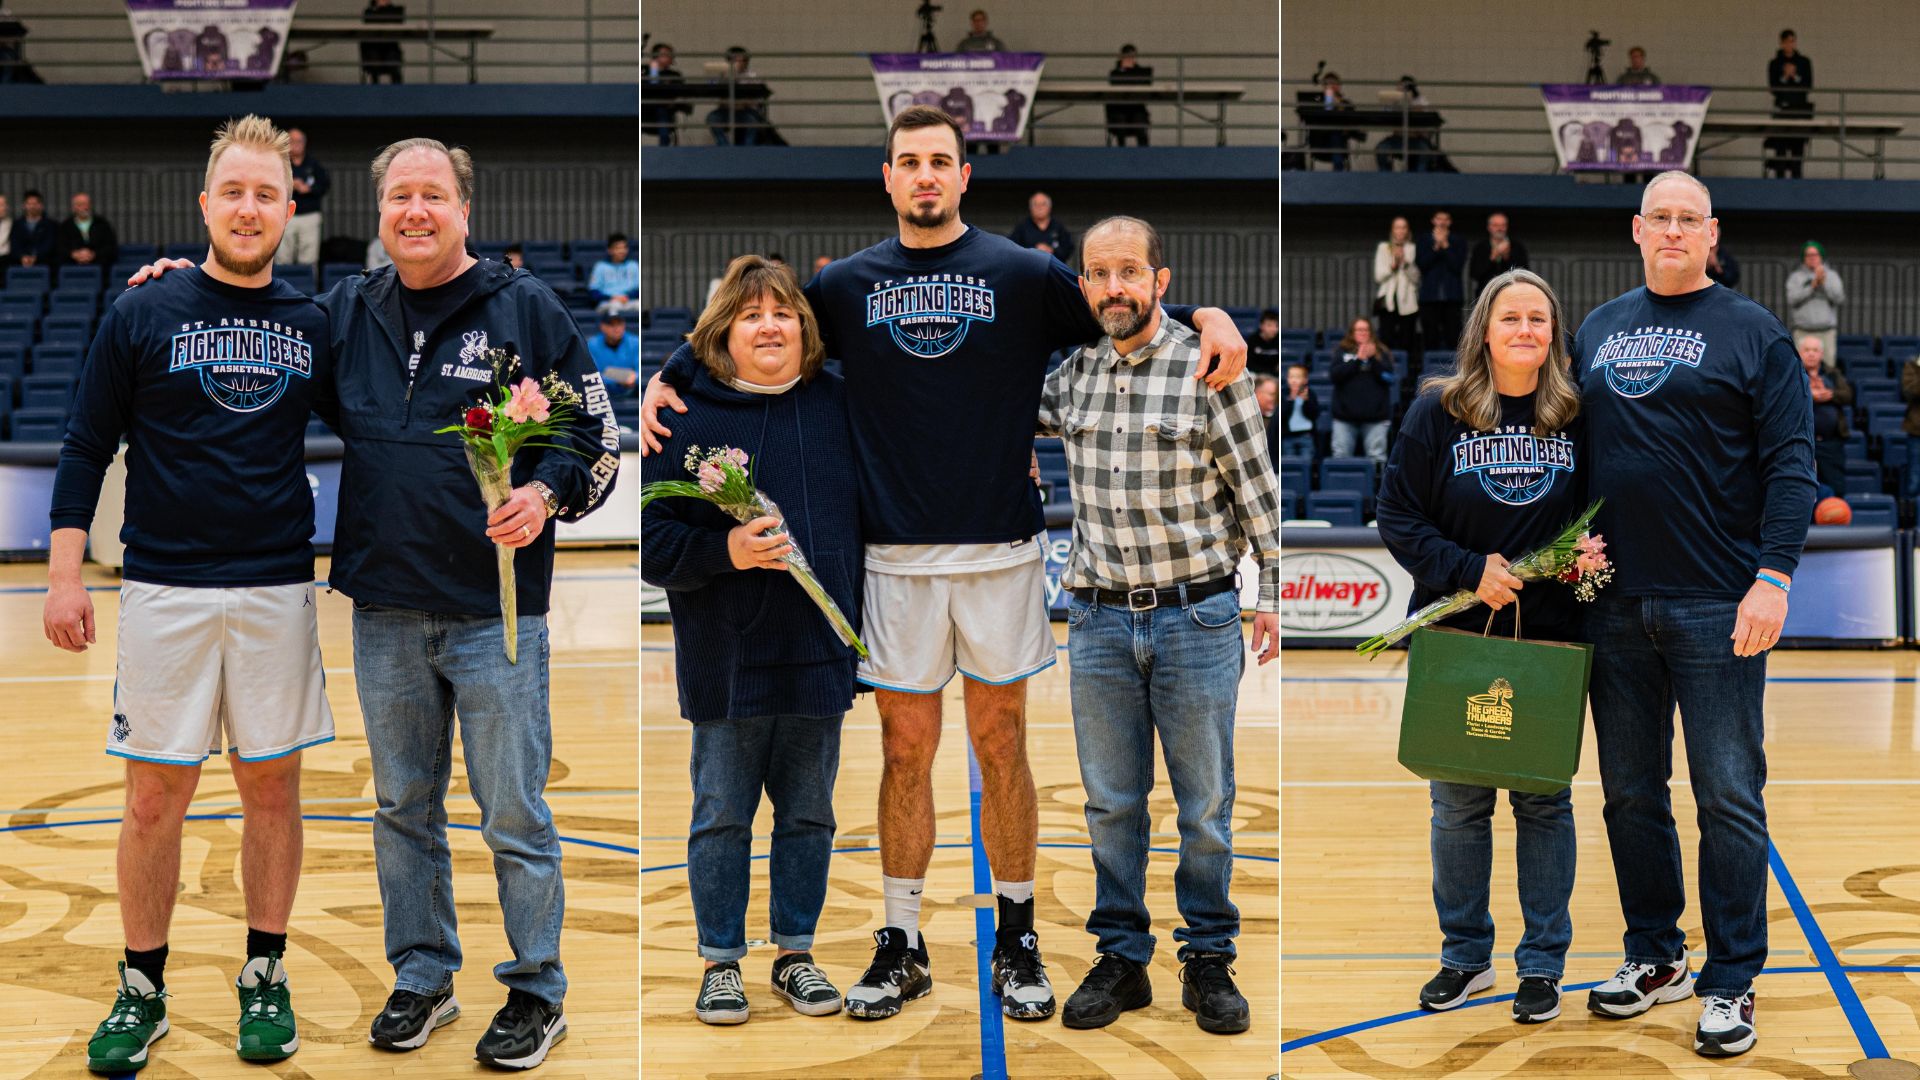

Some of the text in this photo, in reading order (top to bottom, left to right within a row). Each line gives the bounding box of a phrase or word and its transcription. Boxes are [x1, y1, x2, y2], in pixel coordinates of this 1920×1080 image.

[874, 274, 986, 291] ST. AMBROSE
[867, 284, 994, 324] FIGHTING BEES
[900, 315, 958, 325] BASKETBALL
[182, 318, 303, 340] ST. AMBROSE
[1607, 326, 1703, 342] ST. AMBROSE
[171, 330, 311, 375] FIGHTING BEES
[1591, 335, 1706, 370] FIGHTING BEES
[212, 365, 278, 376] BASKETBALL
[1616, 360, 1665, 368] BASKETBALL
[441, 363, 493, 383] ST. AMBROSE
[1495, 425, 1567, 440] AMBSE
[1454, 436, 1574, 474] FIGHTING BEES
[591, 451, 620, 497] BEE
[1489, 467, 1545, 475] BASKETBALL
[1281, 575, 1381, 608] ailways
[1466, 701, 1512, 717] THE GREEN
[1466, 712, 1512, 726] THUMBERS
